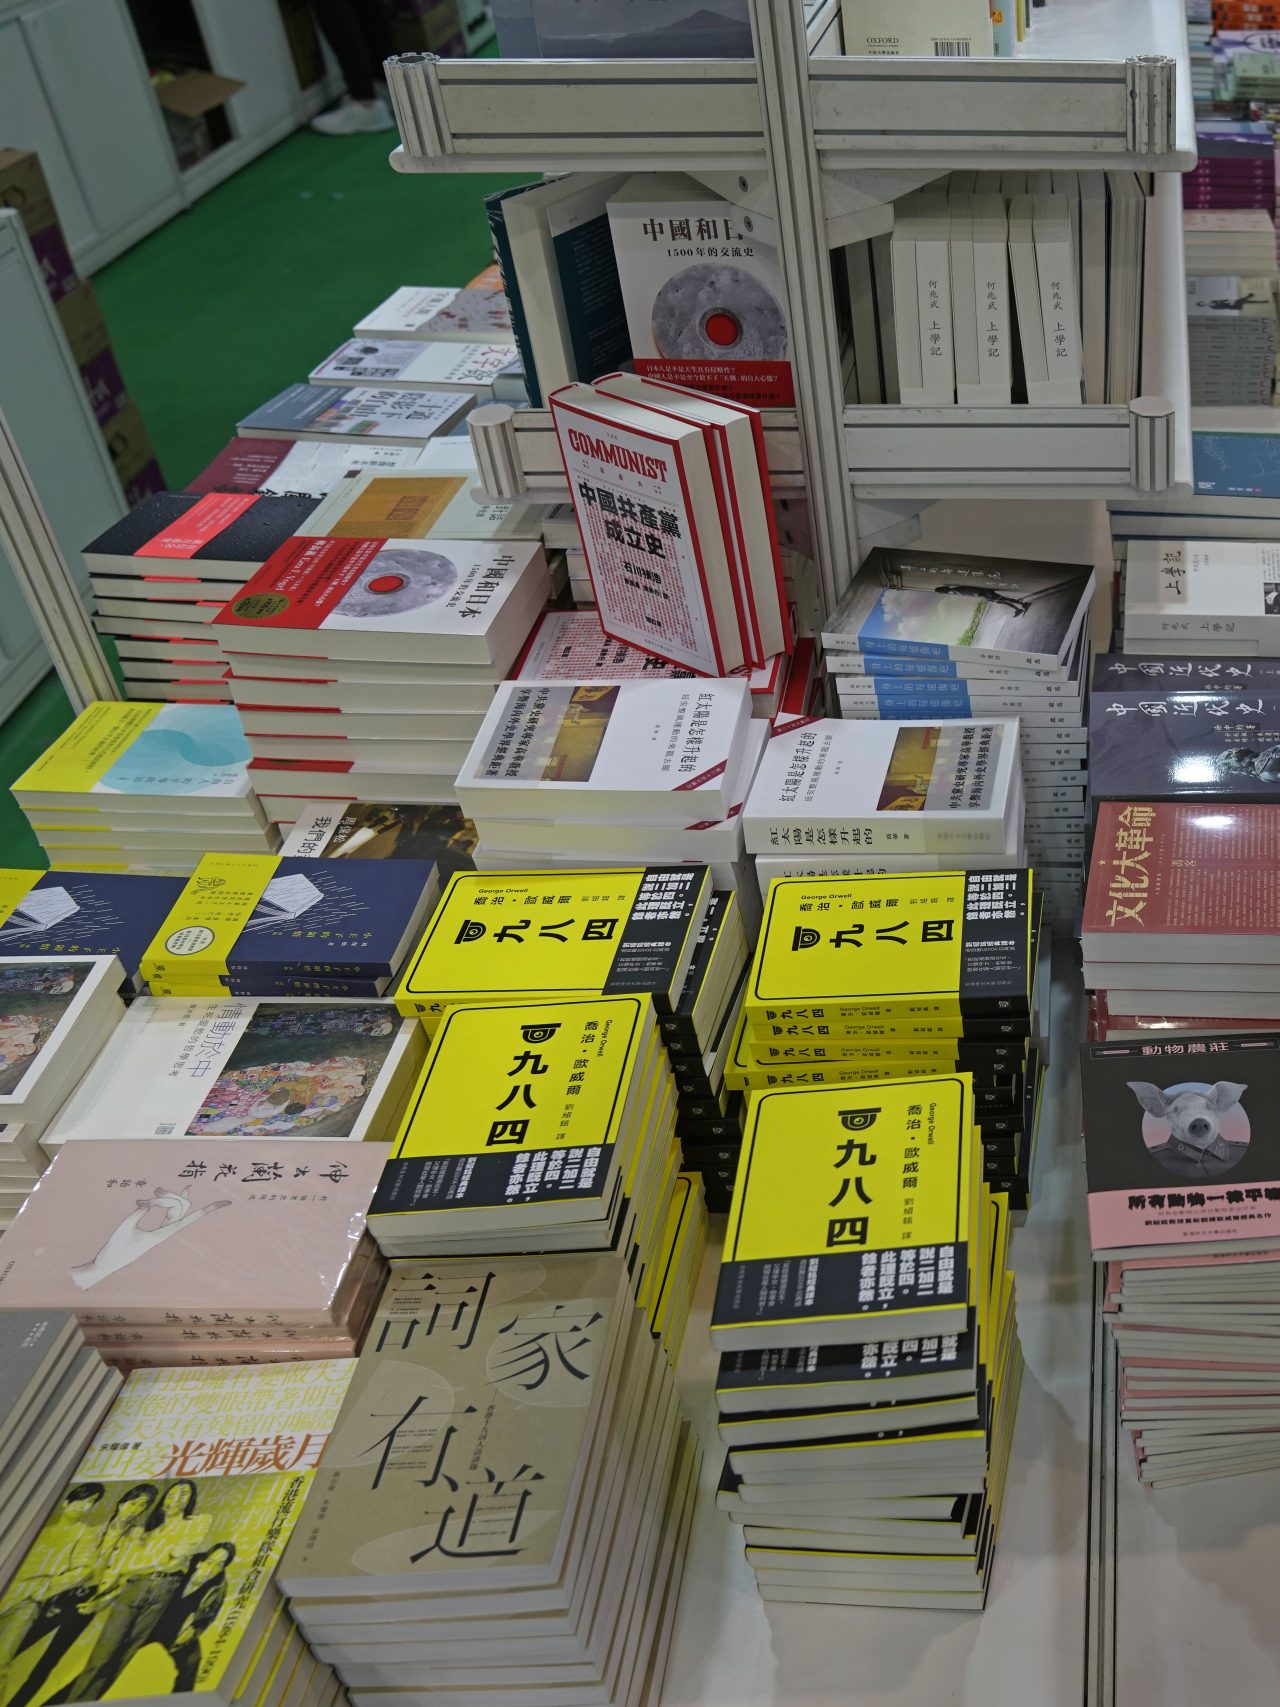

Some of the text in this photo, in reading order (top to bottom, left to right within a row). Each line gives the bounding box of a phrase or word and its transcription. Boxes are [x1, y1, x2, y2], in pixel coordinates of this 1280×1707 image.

[929, 320, 942, 356] 上學記
[986, 322, 1000, 358] 上學記
[1053, 322, 1067, 358] 上學記
[567, 428, 668, 483] COMMUNIST
[578, 482, 682, 539] 中國共產黨
[605, 519, 666, 559] 成立史
[458, 554, 515, 620] 中國和日本
[1108, 662, 1253, 679] 中國近代史
[1106, 699, 1266, 717] 中國近代史
[678, 692, 716, 773] 紅太陽是怎樣升起的
[779, 731, 817, 803] 紅太陽是怎樣升起的
[299, 816, 333, 858] 我們的
[330, 816, 356, 844] 周保松
[770, 827, 873, 846] 紅太陽是怎樣升起的
[1106, 804, 1157, 927] 文化大革命
[453, 918, 620, 945] 一九八四
[791, 919, 955, 951] 一九八四
[766, 1008, 825, 1020] 一九八四
[773, 1024, 830, 1036] 一九八四
[190, 1001, 250, 1078] 情動於中
[566, 1020, 599, 1096] 喬治・歐威爾
[596, 1019, 613, 1058] George Orwell
[770, 1047, 826, 1058] 一九八四
[1141, 1041, 1229, 1056] 動物農莊
[485, 1022, 562, 1147] 一九八四
[767, 1072, 825, 1084] 一九八四
[926, 1103, 937, 1145] George Orwell
[902, 1104, 922, 1189] 喬治・歐威爾
[505, 1152, 532, 1203] 餘者亦然。
[522, 1151, 549, 1201] 此理既立，
[543, 1149, 567, 1189] 等於四。
[558, 1148, 585, 1190] 說二加二
[577, 1147, 602, 1189] 自由就是
[826, 1107, 882, 1248] 一九八四
[857, 1252, 878, 1311] 餘者亦然。
[877, 1251, 897, 1310] 此理既立，
[898, 1249, 917, 1295] 等於四。
[916, 1247, 935, 1296] 說二加二
[937, 1245, 955, 1295] 自由就是
[152, 1433, 331, 1480] 光輝歲月
[354, 1396, 545, 1565] 有道
